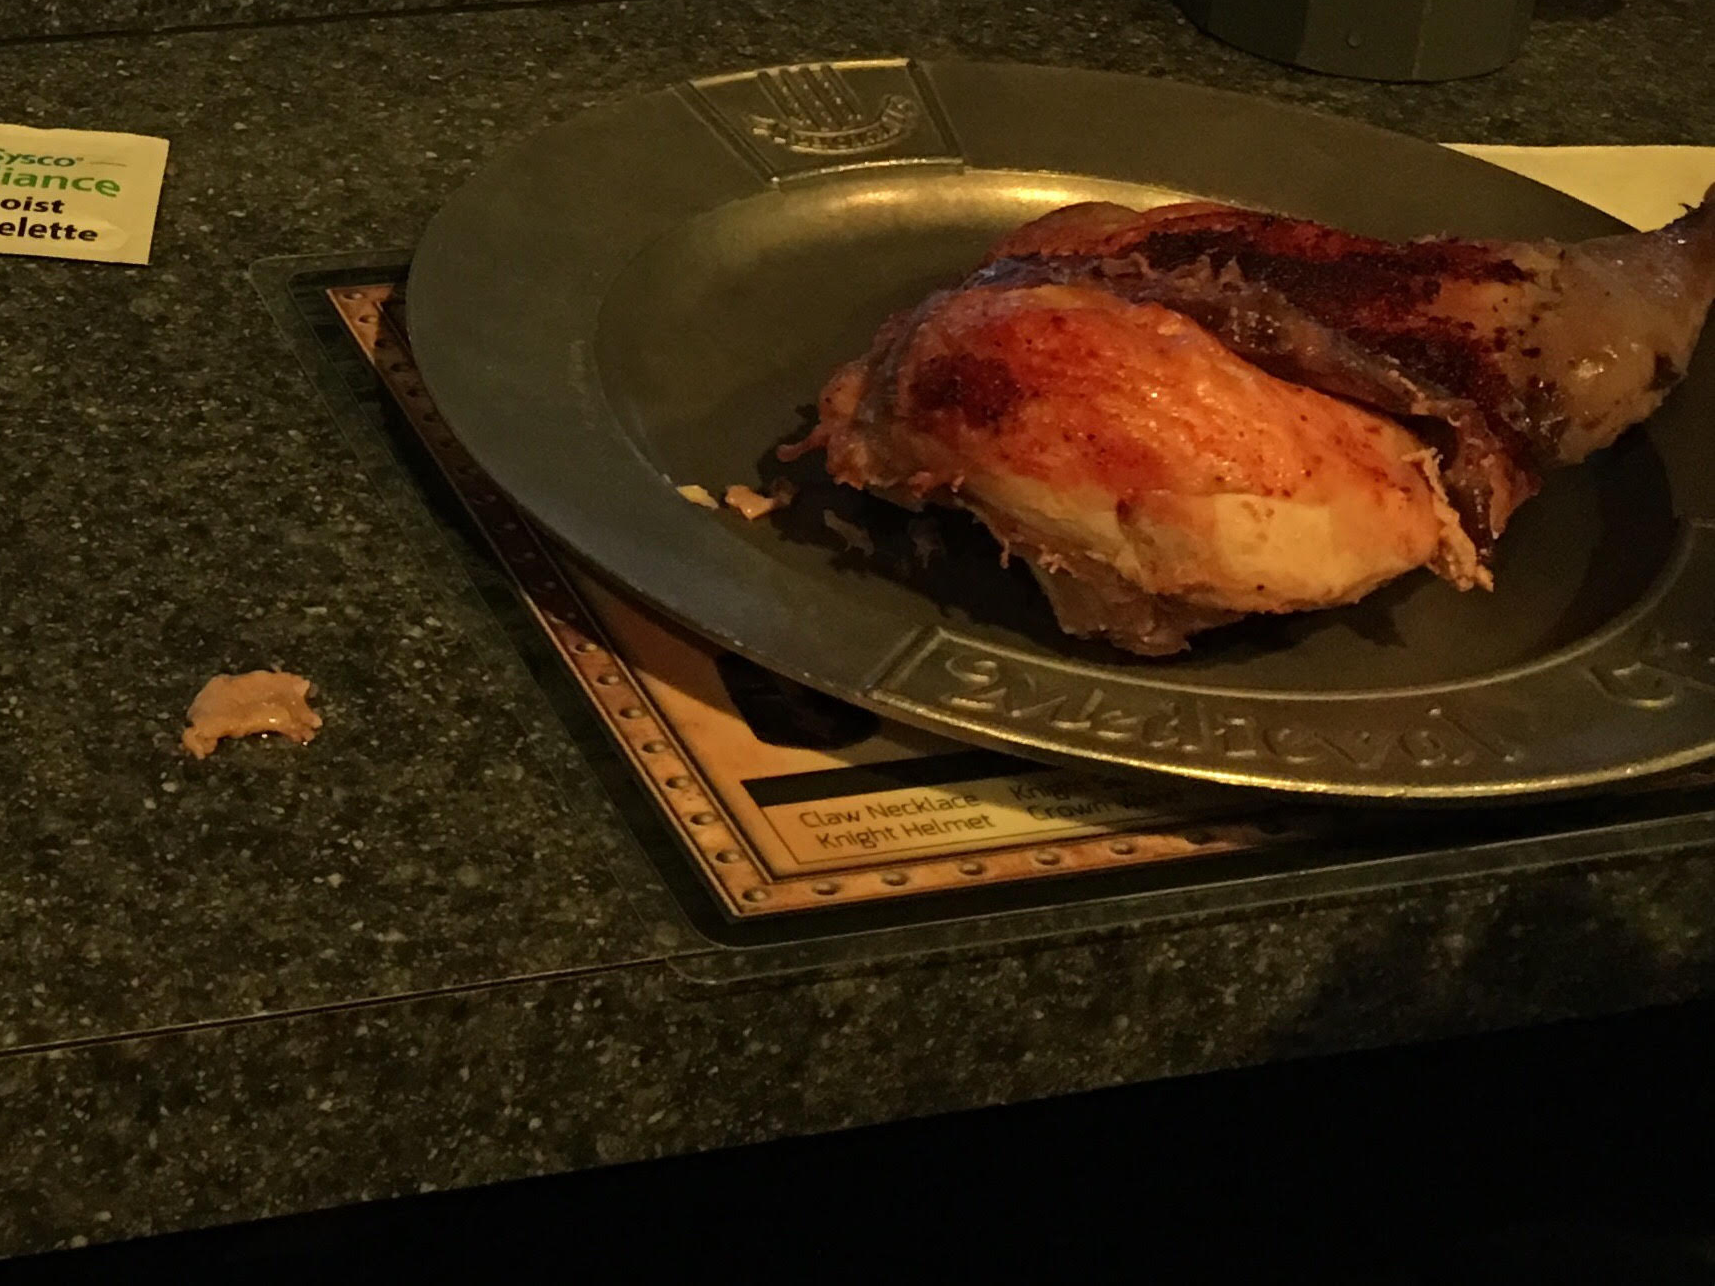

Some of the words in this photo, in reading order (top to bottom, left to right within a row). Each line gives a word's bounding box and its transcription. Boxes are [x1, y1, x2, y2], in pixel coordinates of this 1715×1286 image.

[799, 809, 862, 829] Claw
[866, 791, 981, 823] Necklace
[1027, 800, 1110, 822] Crown
[818, 826, 900, 851] Knight
[904, 812, 996, 839] Helmet
